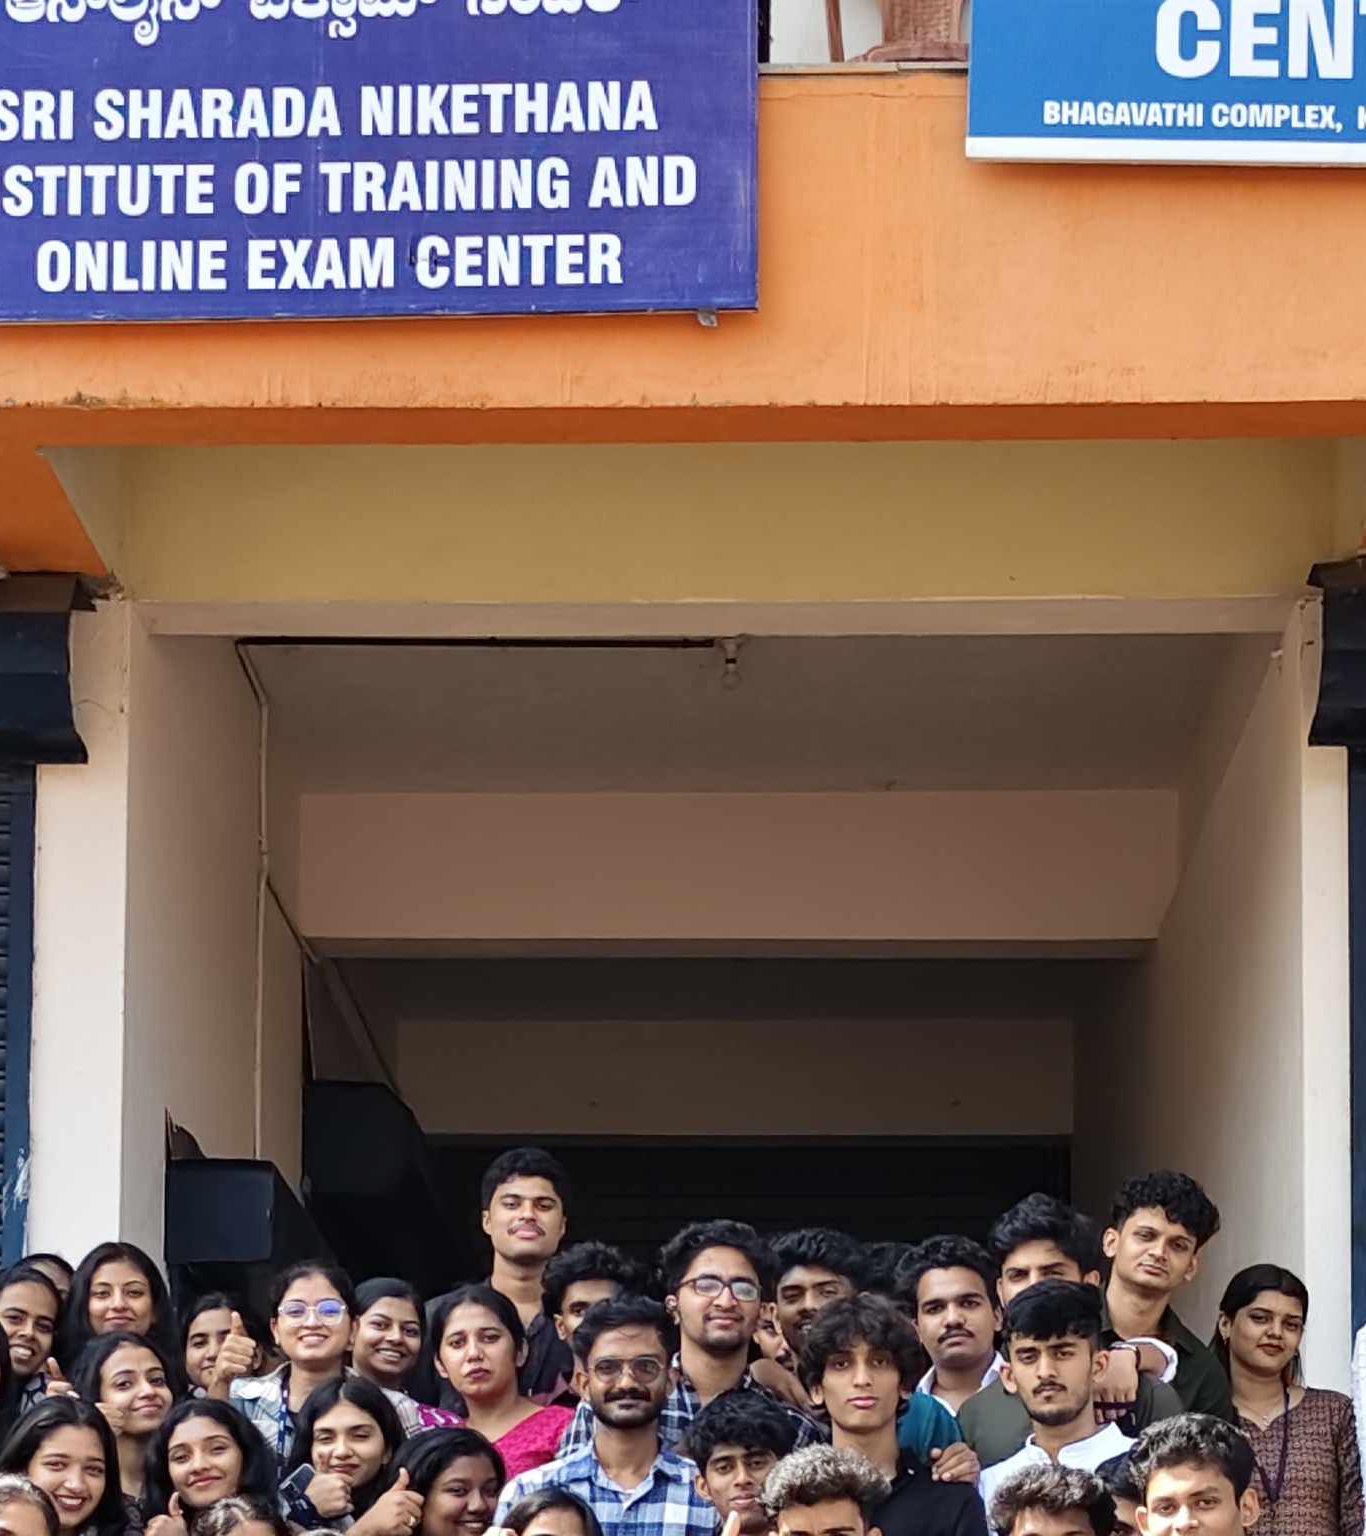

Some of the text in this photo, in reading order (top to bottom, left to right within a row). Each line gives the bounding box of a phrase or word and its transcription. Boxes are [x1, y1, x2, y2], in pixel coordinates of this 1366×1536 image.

[93, 83, 342, 141] SHARADA
[360, 80, 659, 137] NIKETHANA
[1042, 100, 1205, 129] BHAGAVATHI
[1210, 103, 1344, 133] COMPLEX,
[234, 161, 302, 215] OF
[318, 157, 570, 214] TRAINING
[587, 153, 698, 209] AND
[36, 232, 624, 295] ONLINE EXAM CENTER
